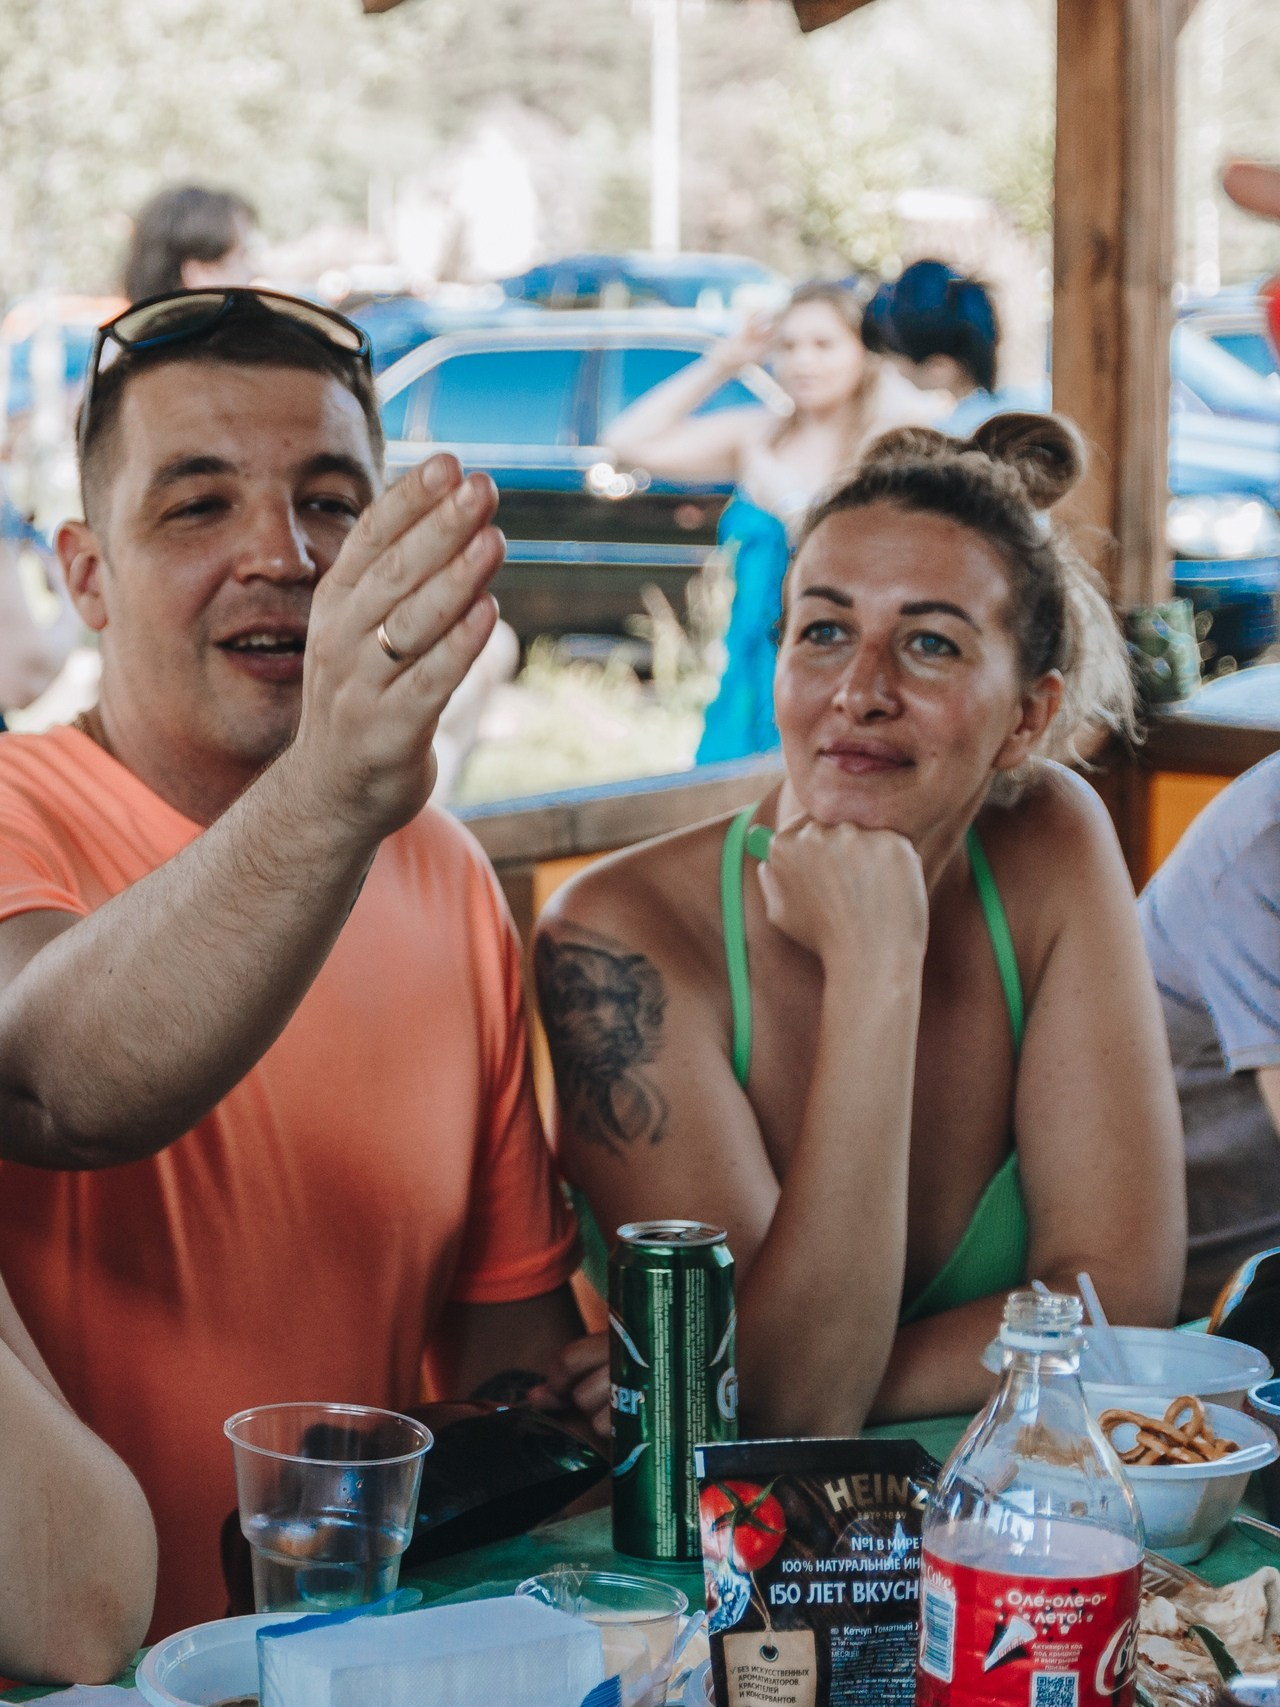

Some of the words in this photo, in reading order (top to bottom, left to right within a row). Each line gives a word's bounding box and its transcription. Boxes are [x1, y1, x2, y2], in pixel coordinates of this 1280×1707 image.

[816, 1558, 901, 1573] НАТУРАЛЬНЫЕ
[770, 1582, 801, 1605] 150
[807, 1582, 846, 1605] ЛЕТ
[843, 1626, 872, 1637] Кетчуп
[874, 1622, 913, 1633] Томатный
[751, 1666, 809, 1676] ИСКУССТВЕННЫХ
[739, 1682, 779, 1694] КРАСИТЕЛЕЙ
[746, 1691, 796, 1703] КОНСЕРВАНТОВ
